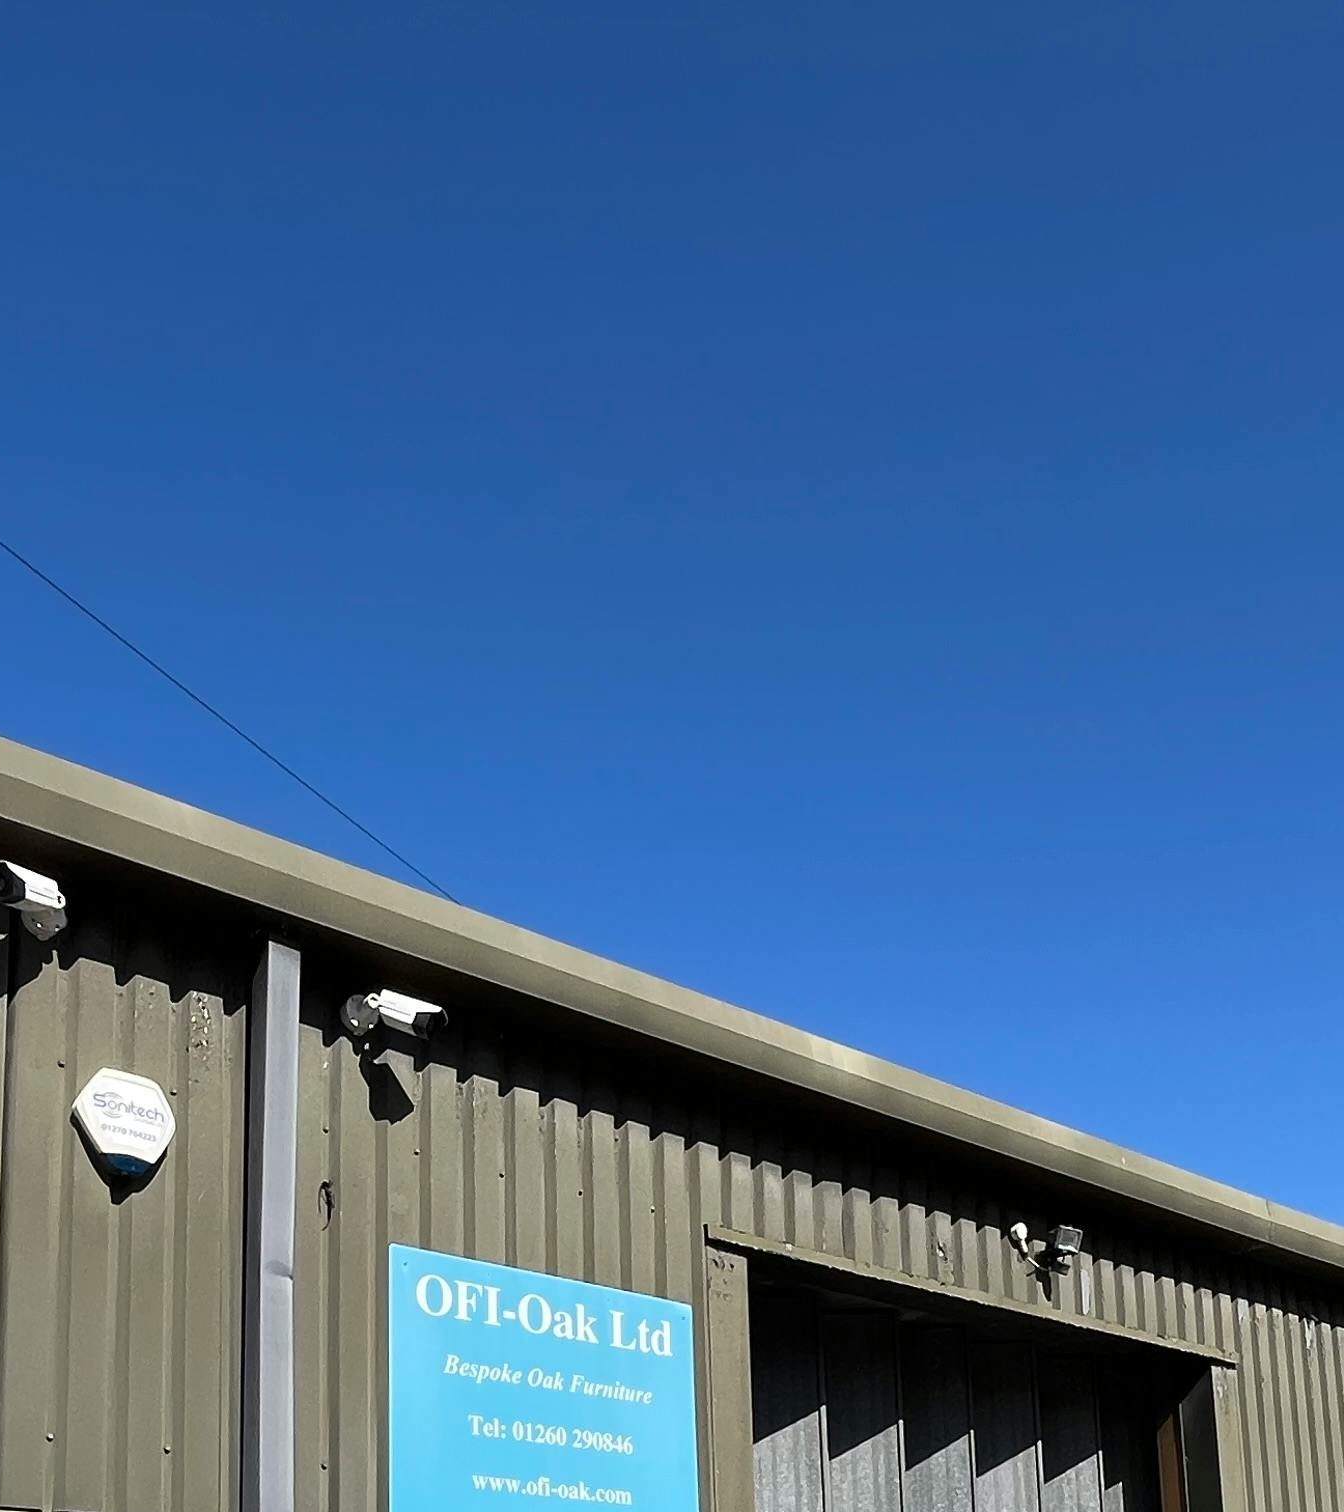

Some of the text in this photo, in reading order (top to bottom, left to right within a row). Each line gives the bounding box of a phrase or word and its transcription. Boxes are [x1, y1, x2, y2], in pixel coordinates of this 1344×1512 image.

[93, 1093, 164, 1122] Sonitech
[416, 1274, 673, 1357] OFI-Oak Ltd
[443, 1354, 653, 1404] Bespoke Oak Furniture
[468, 1414, 634, 1455] Tel: 01260 290846
[472, 1473, 633, 1506] www.ofi-oak.com
